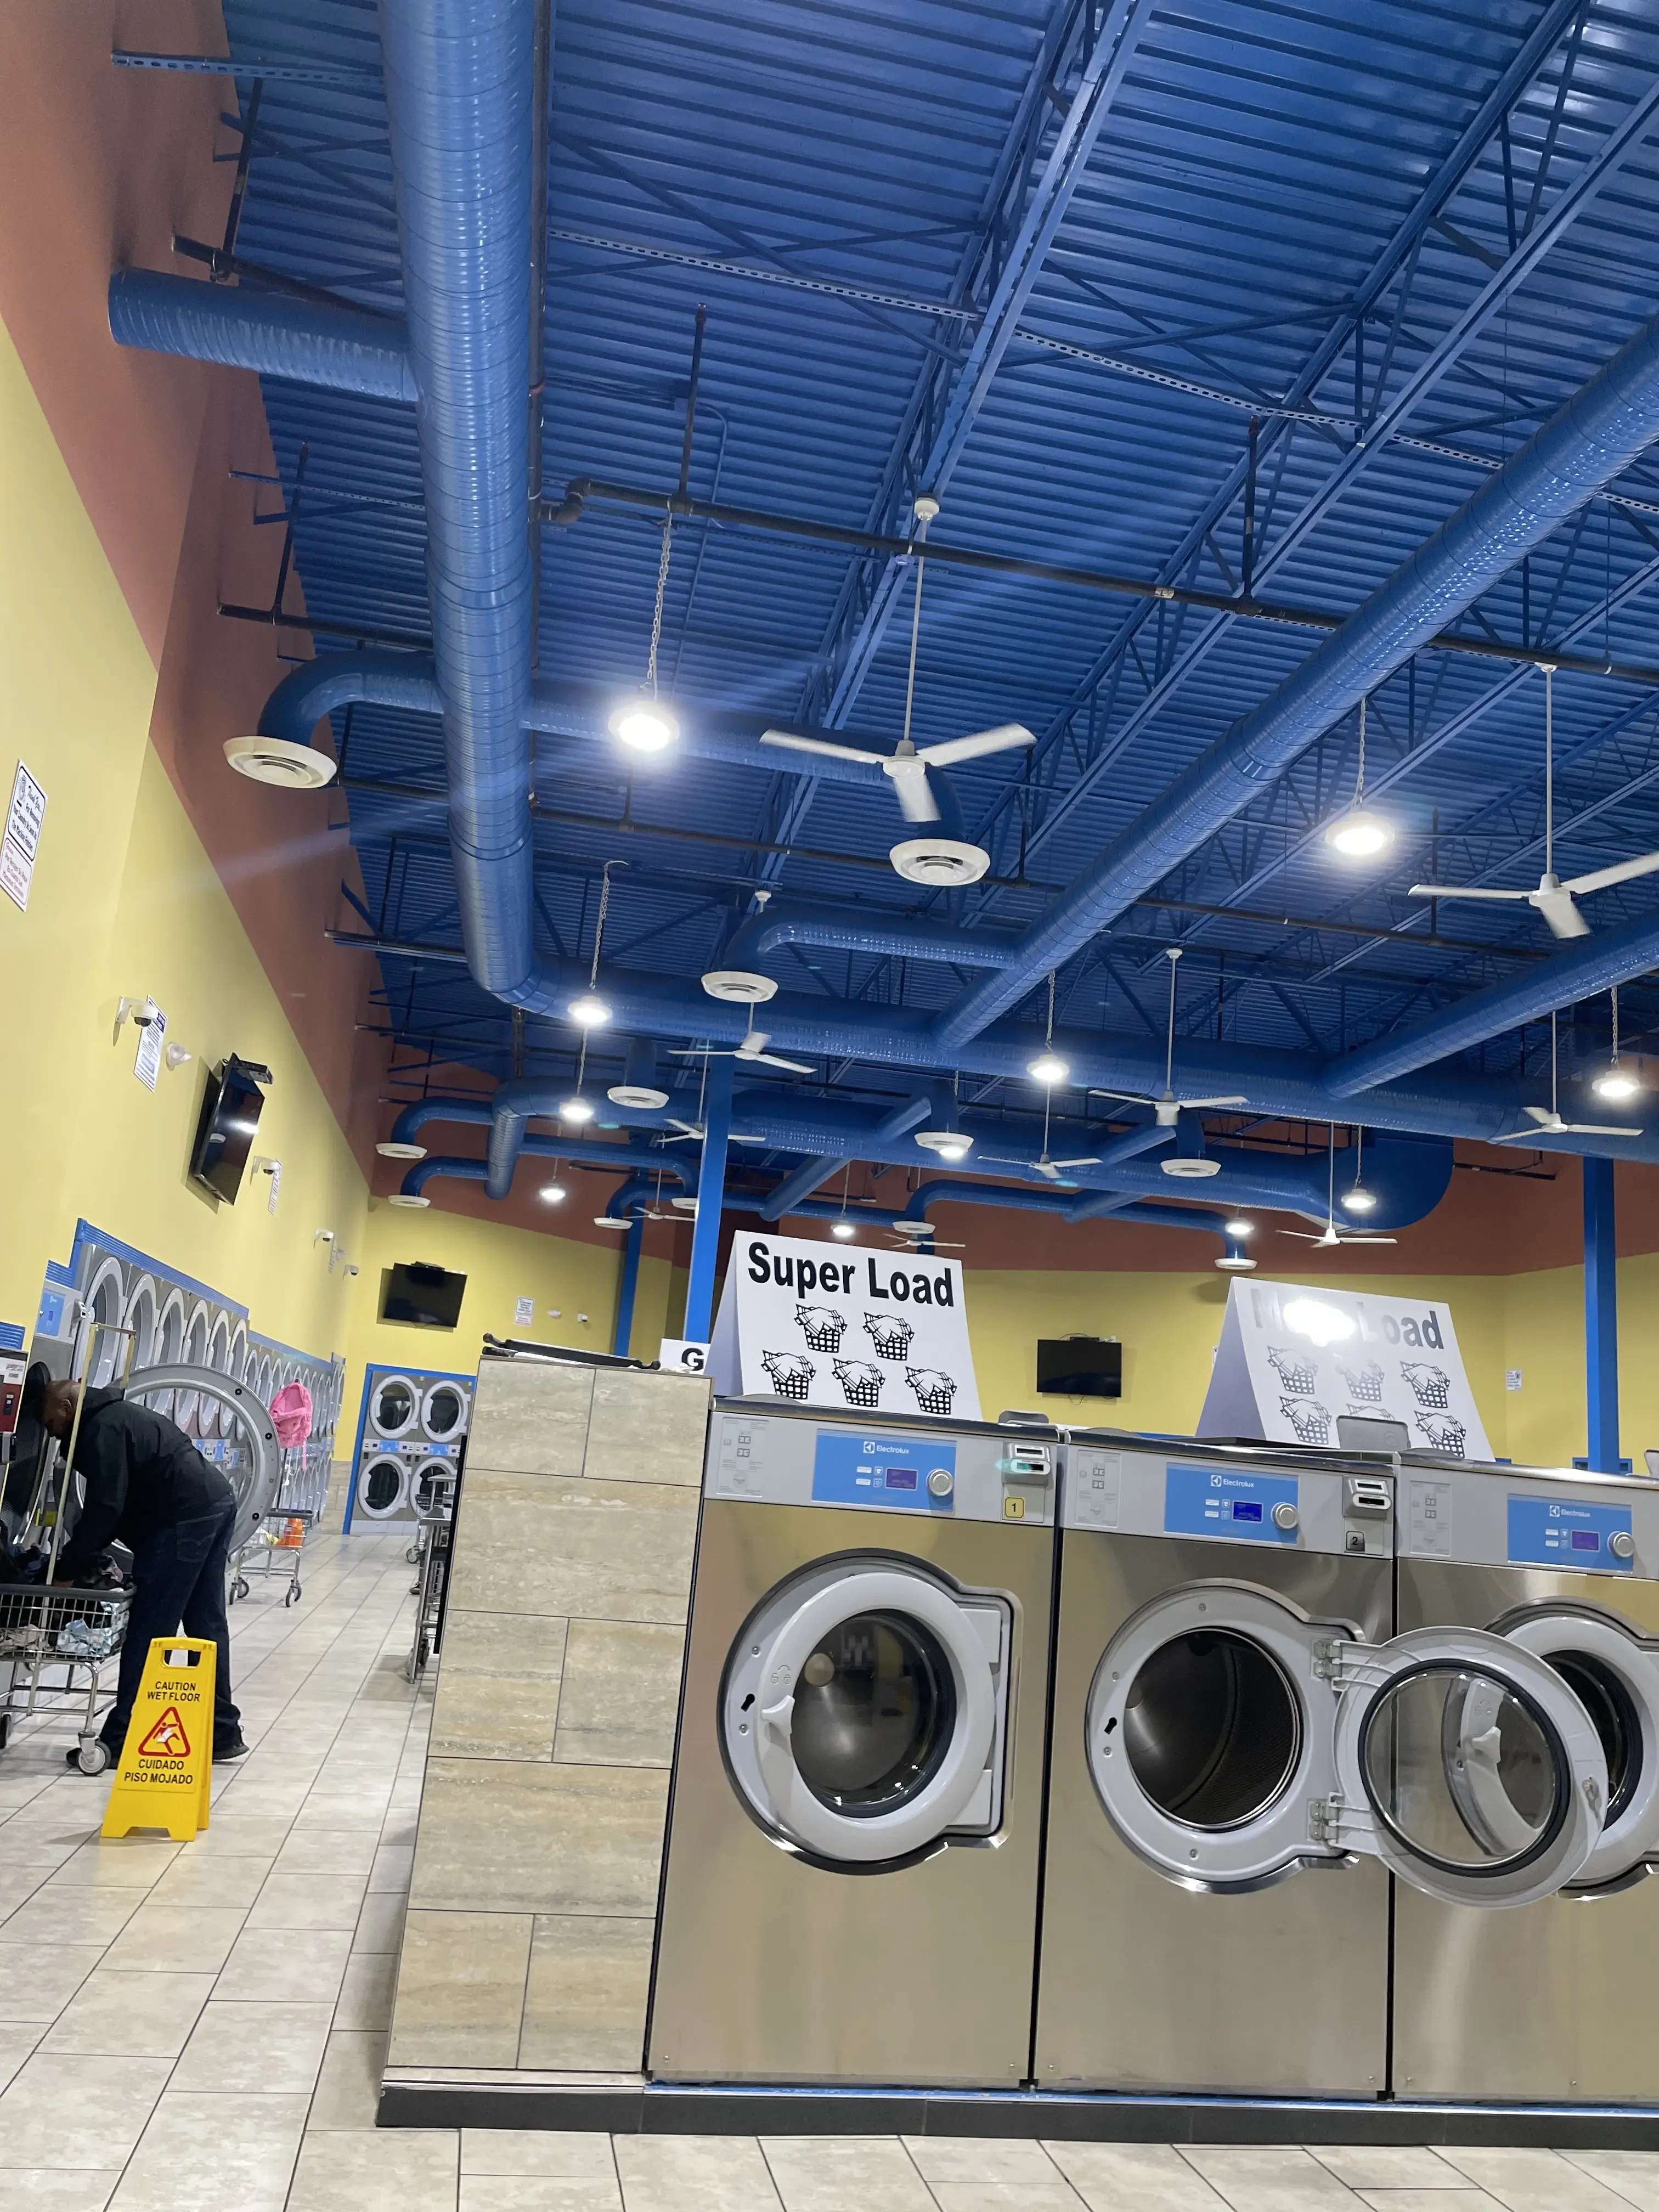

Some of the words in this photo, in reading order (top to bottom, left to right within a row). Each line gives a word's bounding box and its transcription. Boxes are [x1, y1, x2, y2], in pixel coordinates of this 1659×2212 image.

[748, 1242, 855, 1298] Super
[868, 1257, 953, 1307] Load
[1357, 1301, 1444, 1350] Load
[681, 1347, 704, 1371] G
[876, 1444, 910, 1454] Electrolux
[1223, 1478, 1255, 1488] Electrolux
[1012, 1503, 1017, 1513] 1
[1352, 1536, 1358, 1545] 2
[155, 1680, 196, 1691] CAUTION
[147, 1691, 168, 1701] WET
[168, 1691, 200, 1702] FLOOR
[138, 1759, 184, 1770] CUIDADO
[124, 1772, 148, 1783] PISO
[150, 1773, 193, 1785] MOJADO
